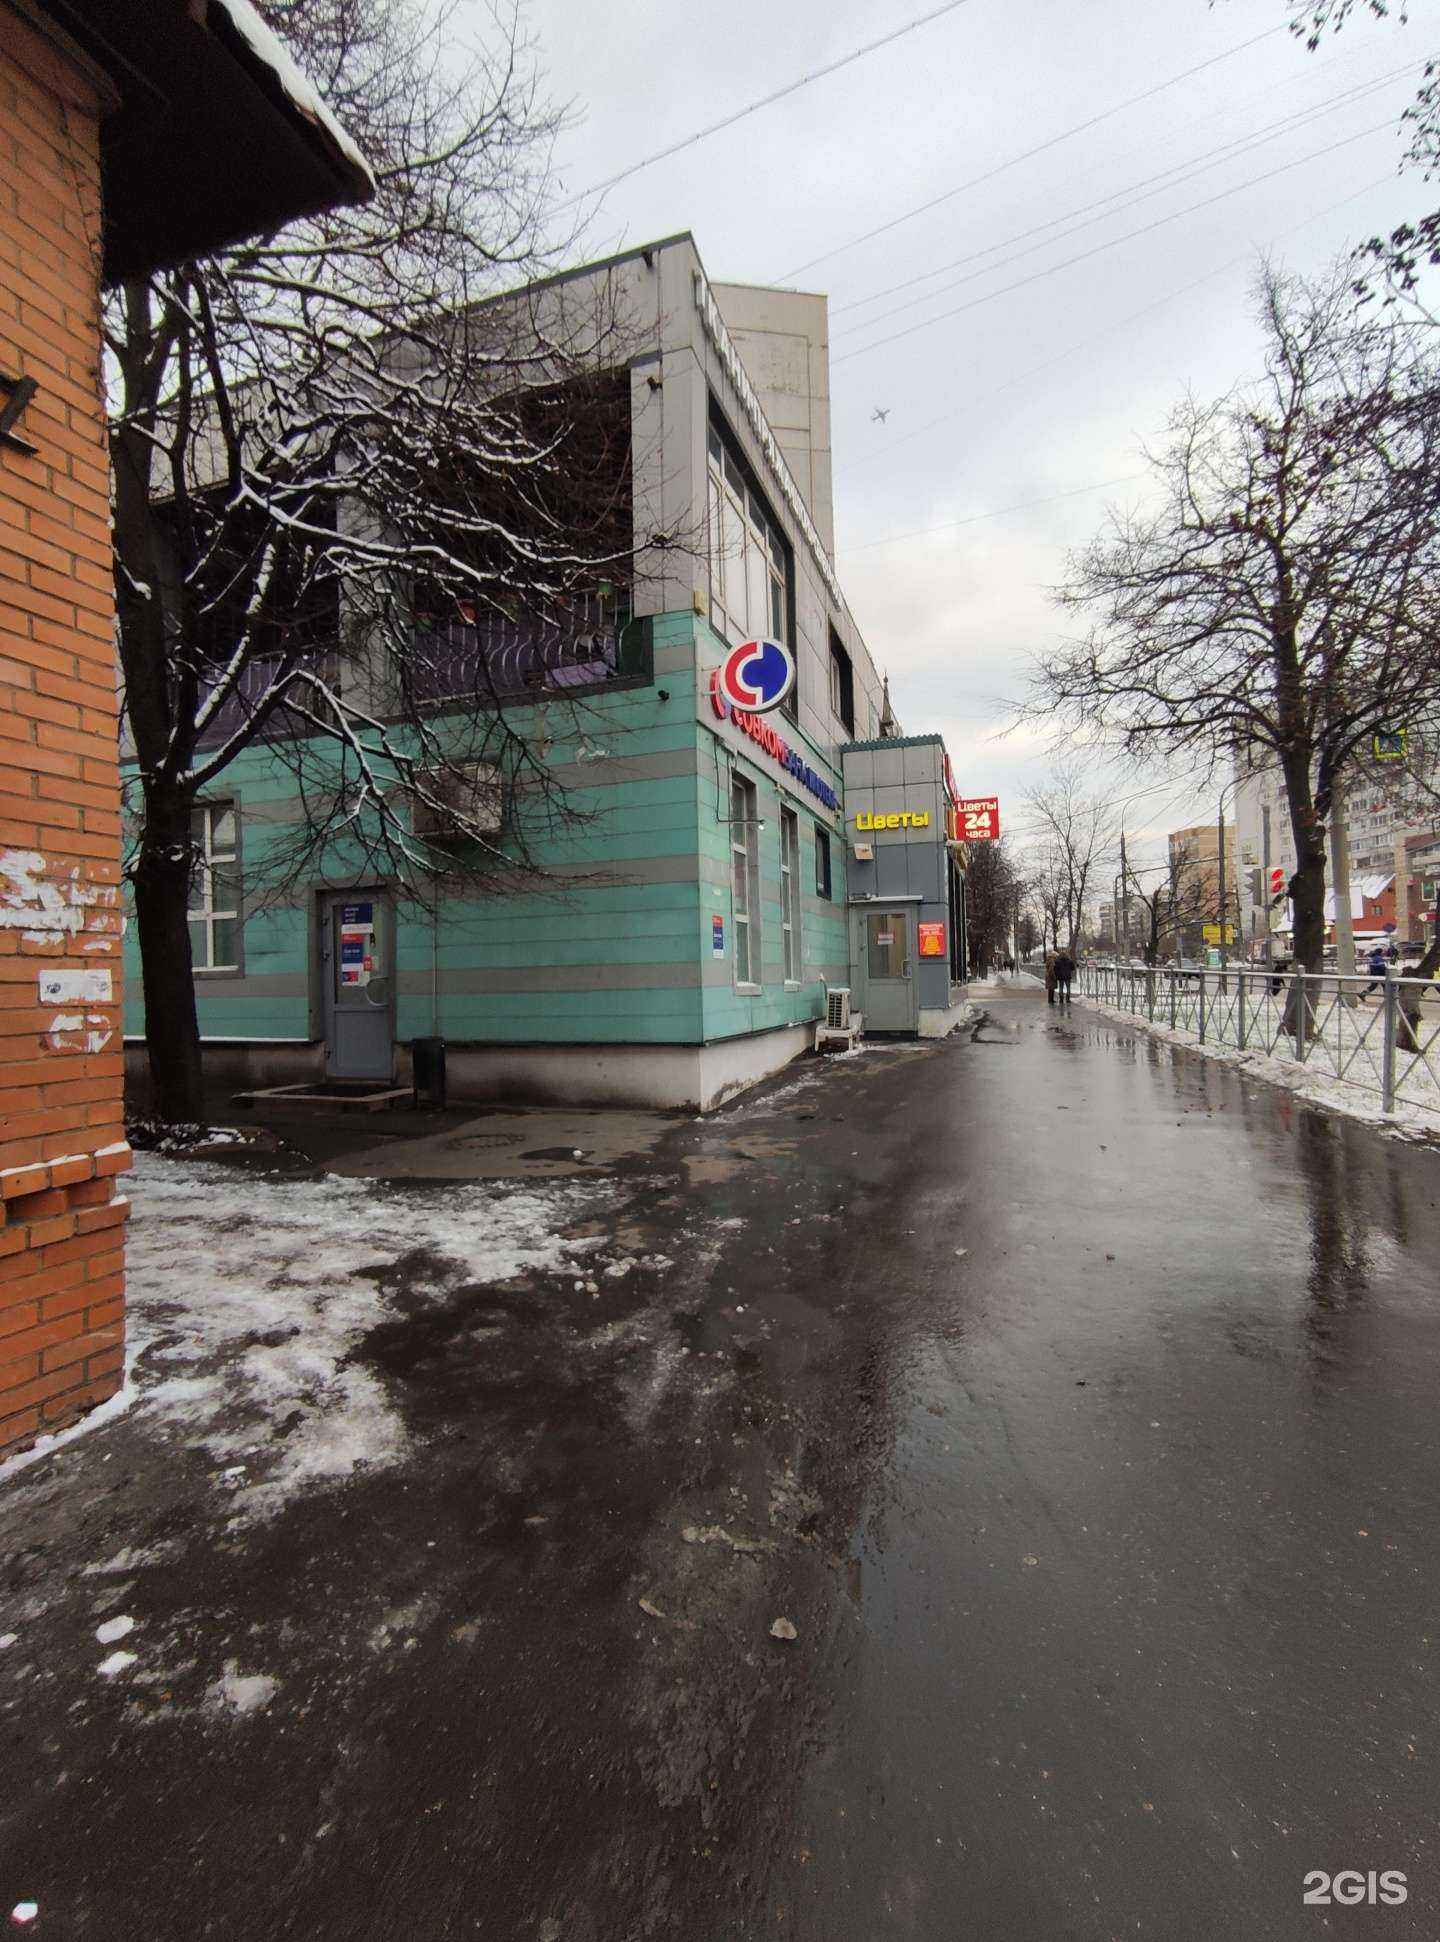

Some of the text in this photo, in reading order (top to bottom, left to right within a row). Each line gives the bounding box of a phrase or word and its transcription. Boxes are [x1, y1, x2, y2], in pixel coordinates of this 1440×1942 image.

[730, 706, 837, 811] СОВКОМ
[958, 801, 997, 813] Цветы
[856, 811, 929, 831] Цветы
[965, 811, 992, 829] 24
[965, 829, 991, 839] часа
